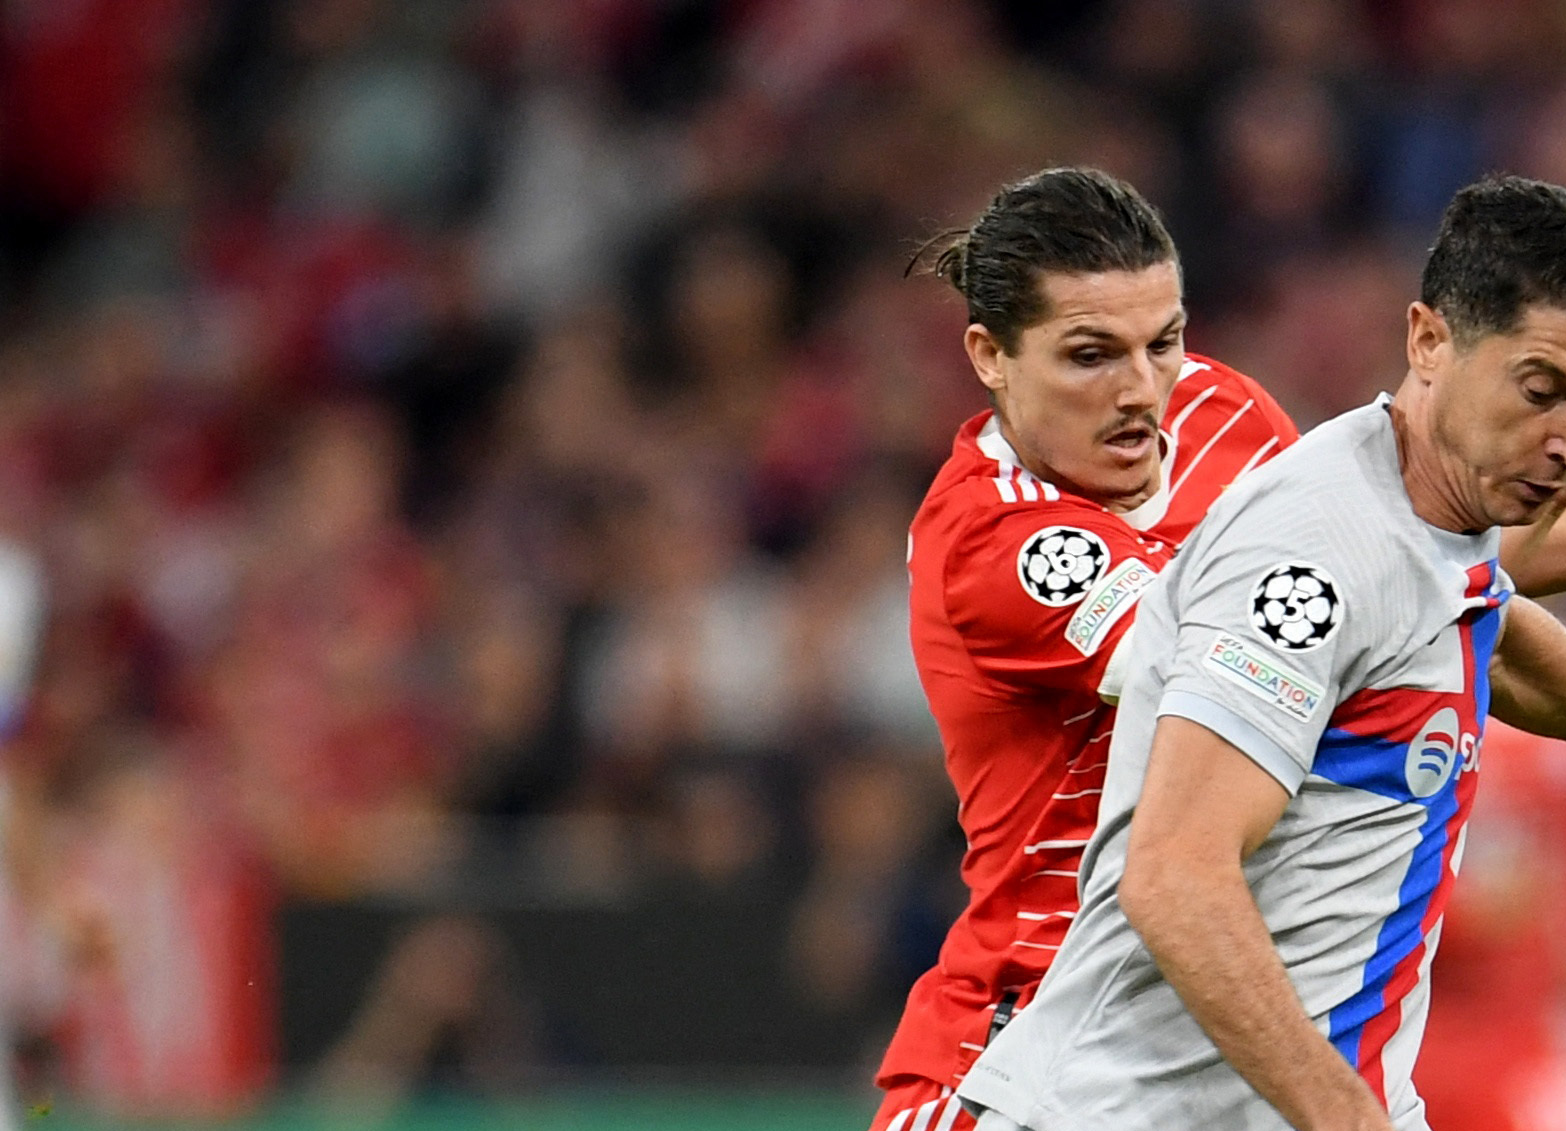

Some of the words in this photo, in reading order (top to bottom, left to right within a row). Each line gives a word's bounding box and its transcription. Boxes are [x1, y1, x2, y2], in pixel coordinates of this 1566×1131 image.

[1074, 567, 1148, 646] FOUNDATION
[1281, 588, 1306, 622] 5
[1212, 643, 1318, 710] FOUNDATION
